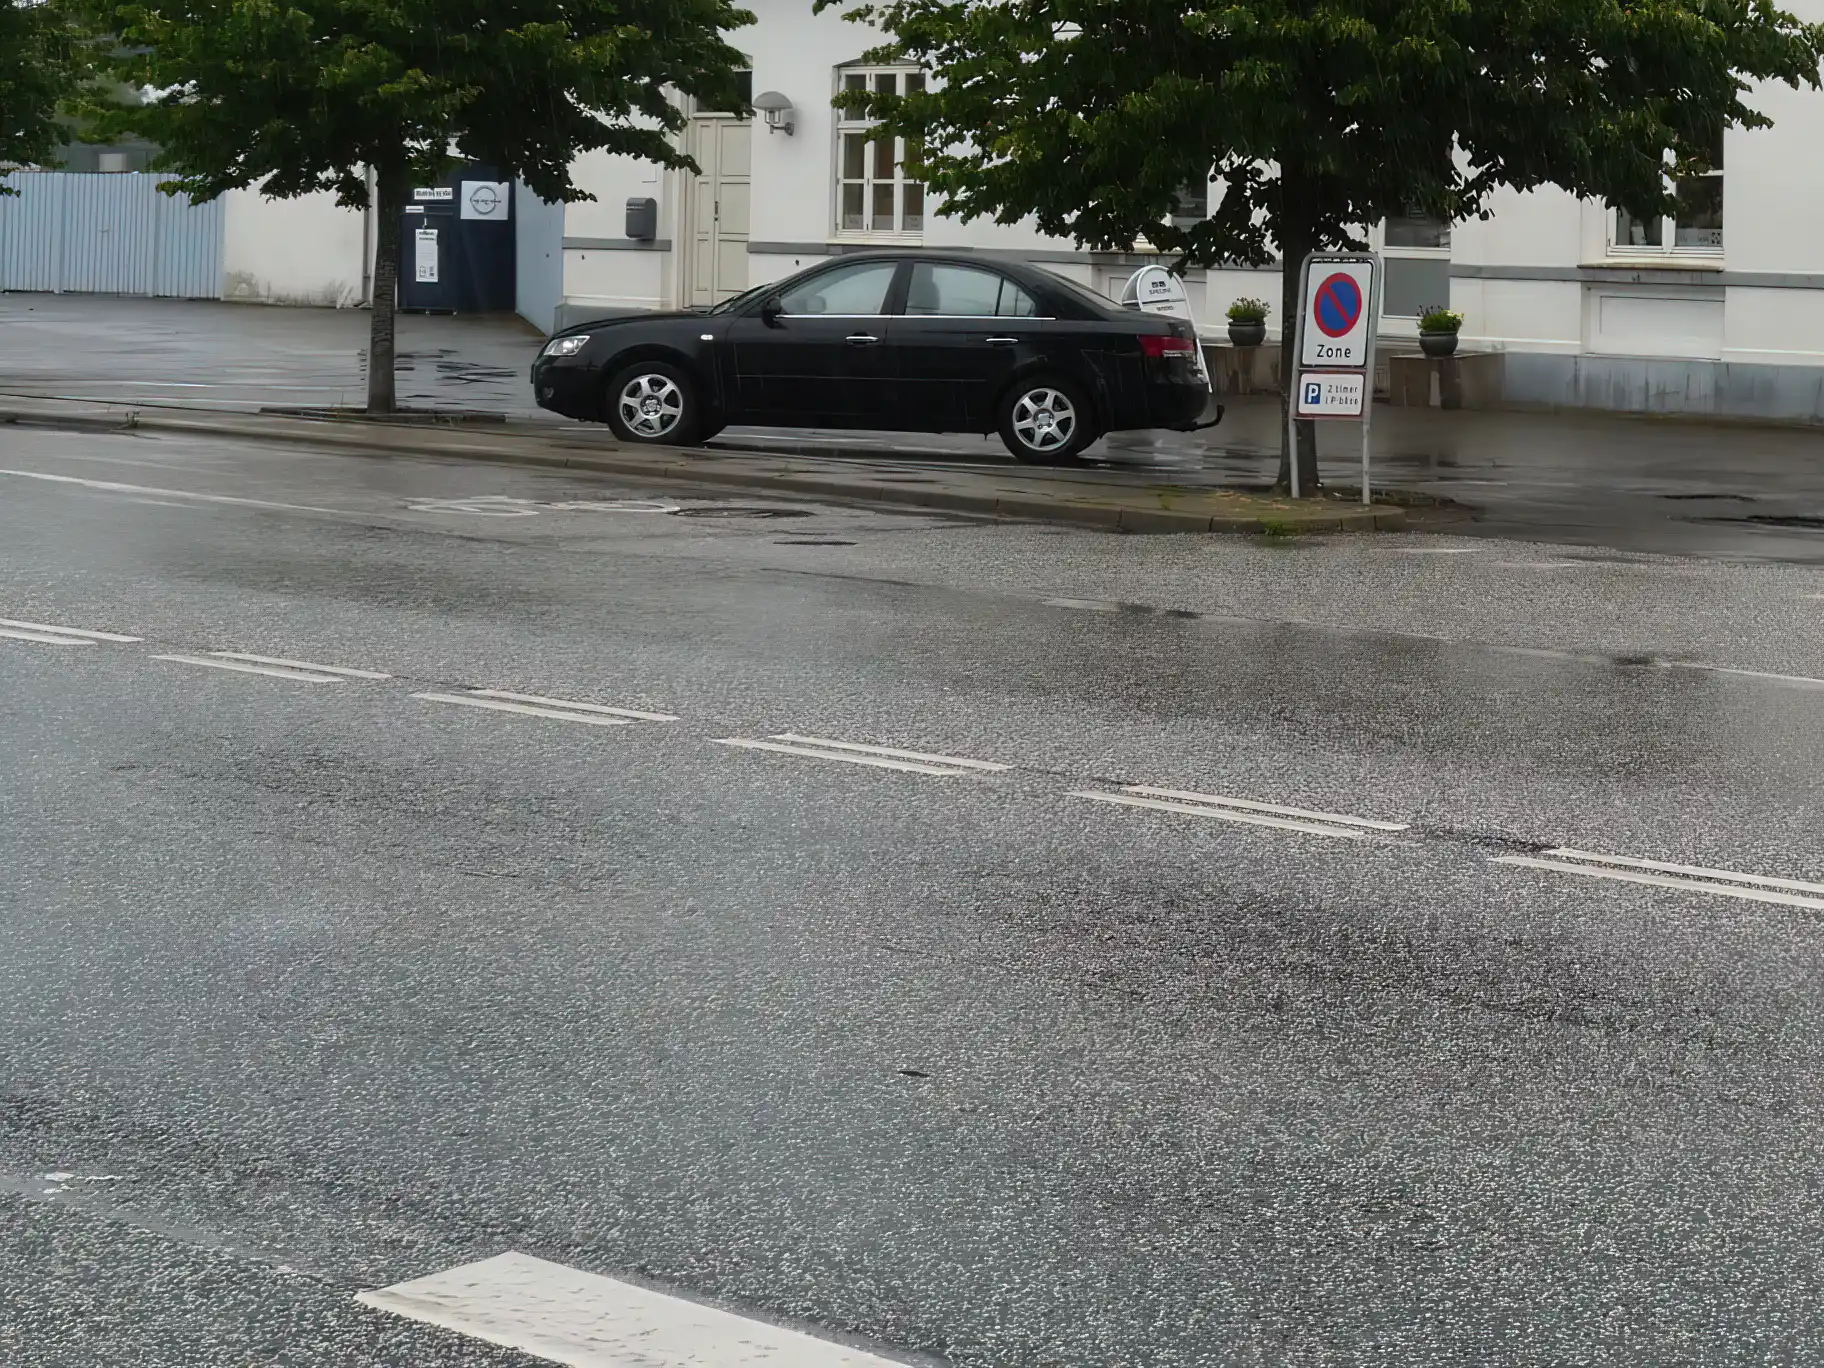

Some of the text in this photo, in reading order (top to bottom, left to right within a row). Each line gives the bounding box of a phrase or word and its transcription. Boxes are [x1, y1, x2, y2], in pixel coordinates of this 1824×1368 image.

[1316, 344, 1352, 358] Zone
[1307, 384, 1319, 403] P
[1327, 384, 1333, 393] 2
